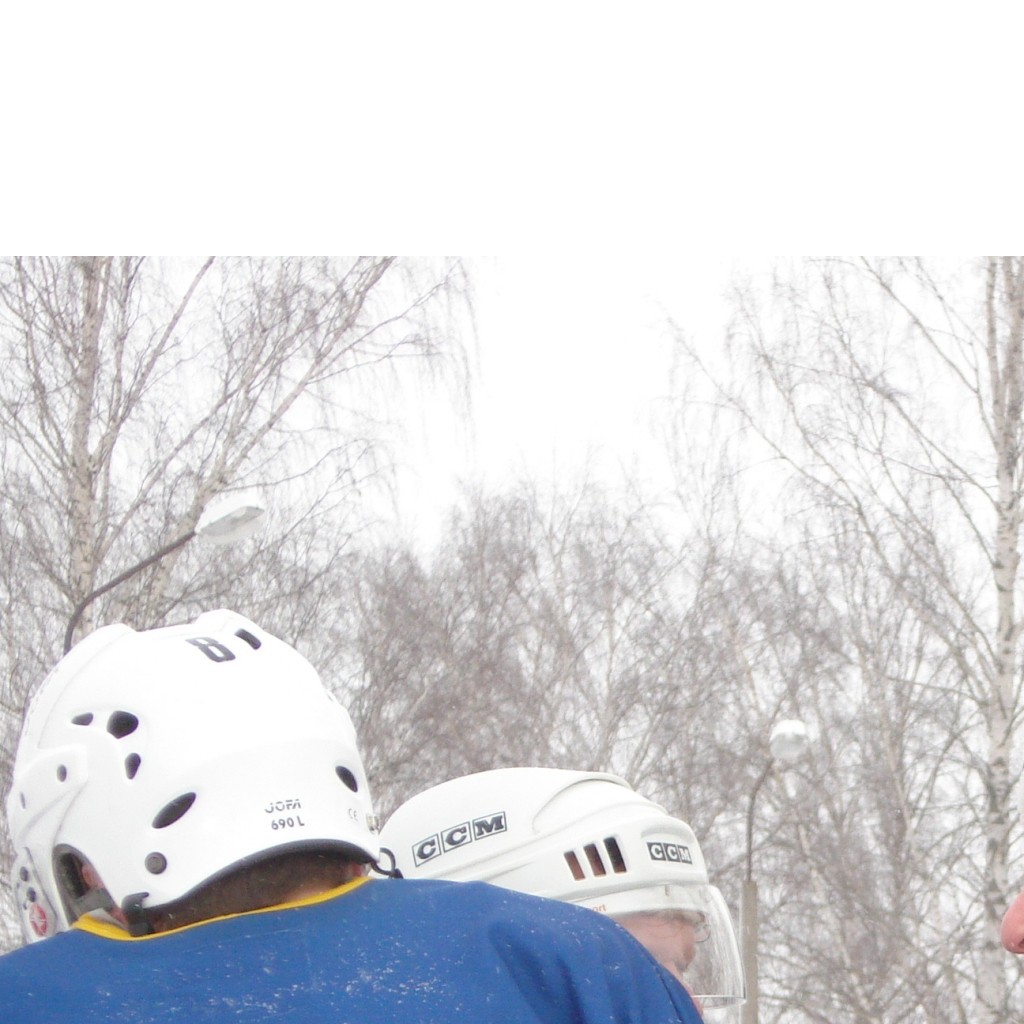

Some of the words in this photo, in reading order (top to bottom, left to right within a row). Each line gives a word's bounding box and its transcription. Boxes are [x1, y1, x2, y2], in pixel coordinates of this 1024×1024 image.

[264, 799, 302, 814] JOFA
[271, 817, 295, 831] 690
[296, 815, 305, 827] L
[415, 813, 506, 862] CCM
[648, 843, 692, 864] CCM
